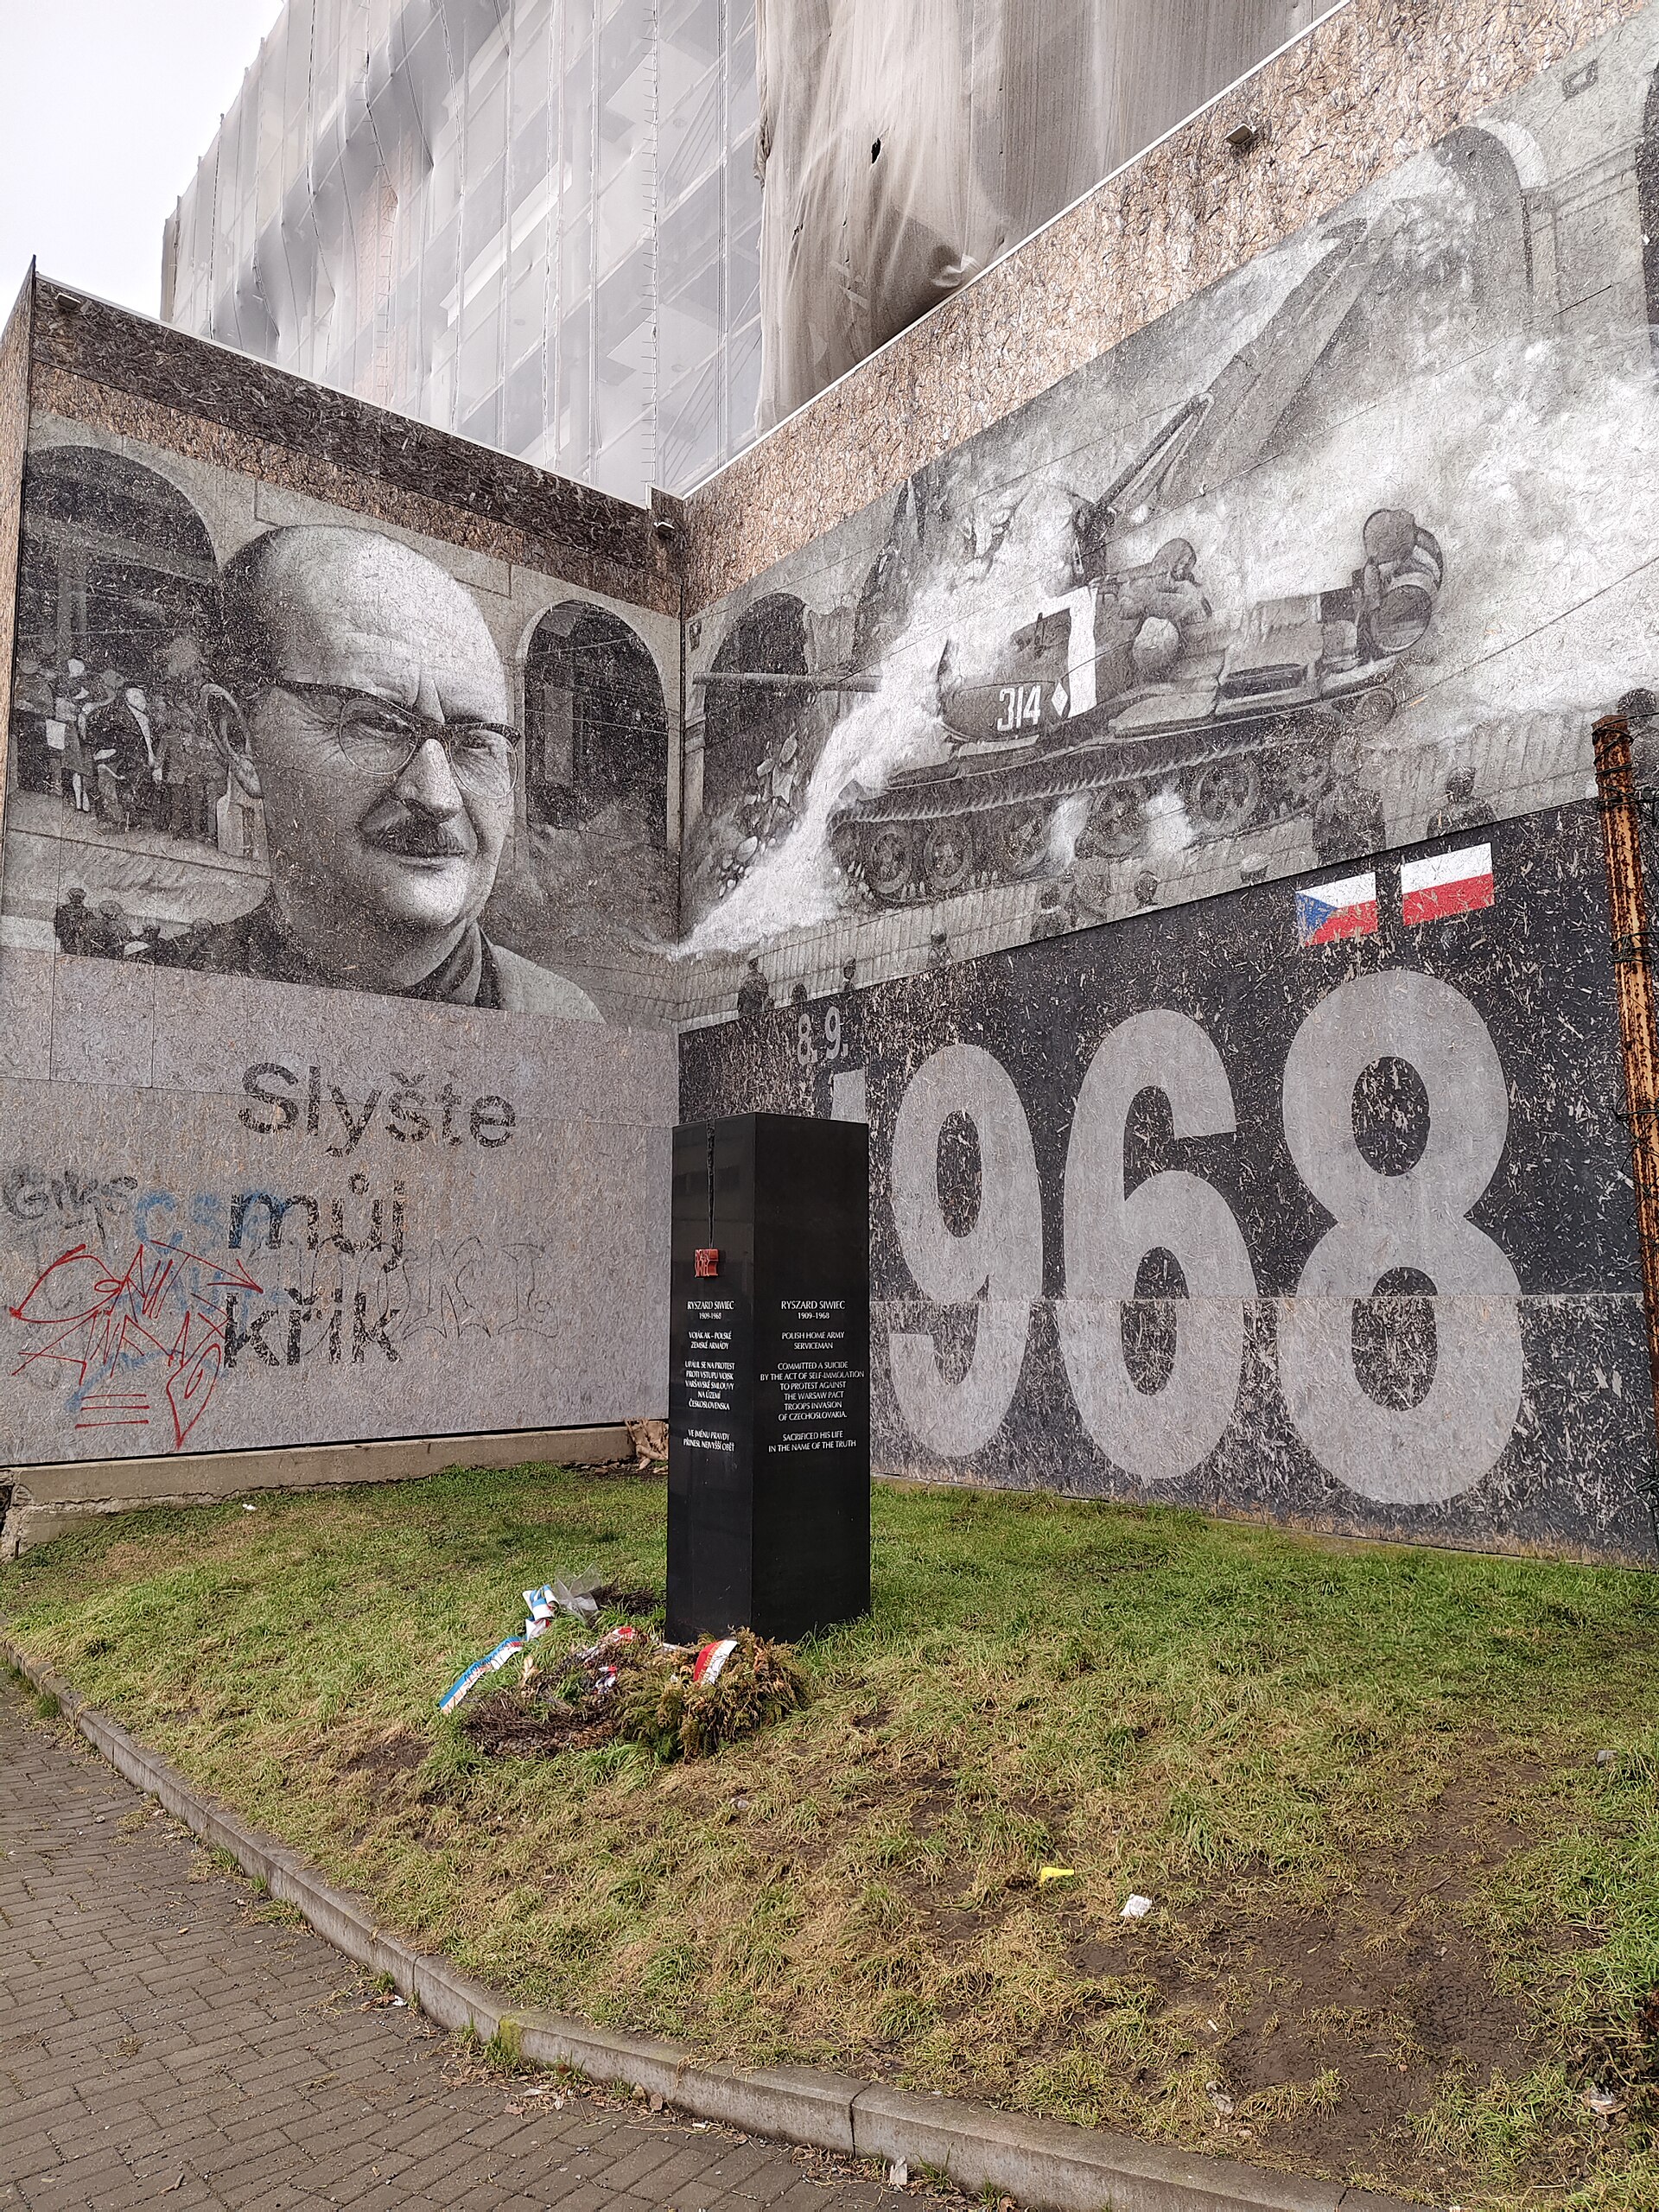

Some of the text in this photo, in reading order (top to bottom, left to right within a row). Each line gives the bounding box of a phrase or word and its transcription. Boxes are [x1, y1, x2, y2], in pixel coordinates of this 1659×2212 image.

[997, 685, 1040, 732] 314
[238, 1063, 516, 1158] Slyšte
[228, 1173, 406, 1273] můj
[830, 969, 1523, 1504] 968
[687, 1301, 734, 1309] RYSZARD SIWIEC
[781, 1301, 845, 1309] RYSZARD SIWIEC
[223, 1287, 403, 1368] křik
[714, 1331, 732, 1339] POLSKÉ
[691, 1340, 729, 1349] ZEMSKÉ ARMÁDY
[719, 1372, 734, 1381] VOJSK
[809, 1371, 864, 1379] SELF-IMMOLATION
[689, 1398, 730, 1410] ČESKOSLOVENSKA
[784, 1402, 810, 1410] TROOPS
[789, 1411, 847, 1420] CZECHOSLOVAKIA.
[711, 1432, 729, 1441] PRAVDY
[783, 1432, 818, 1441] SACRIFICED
